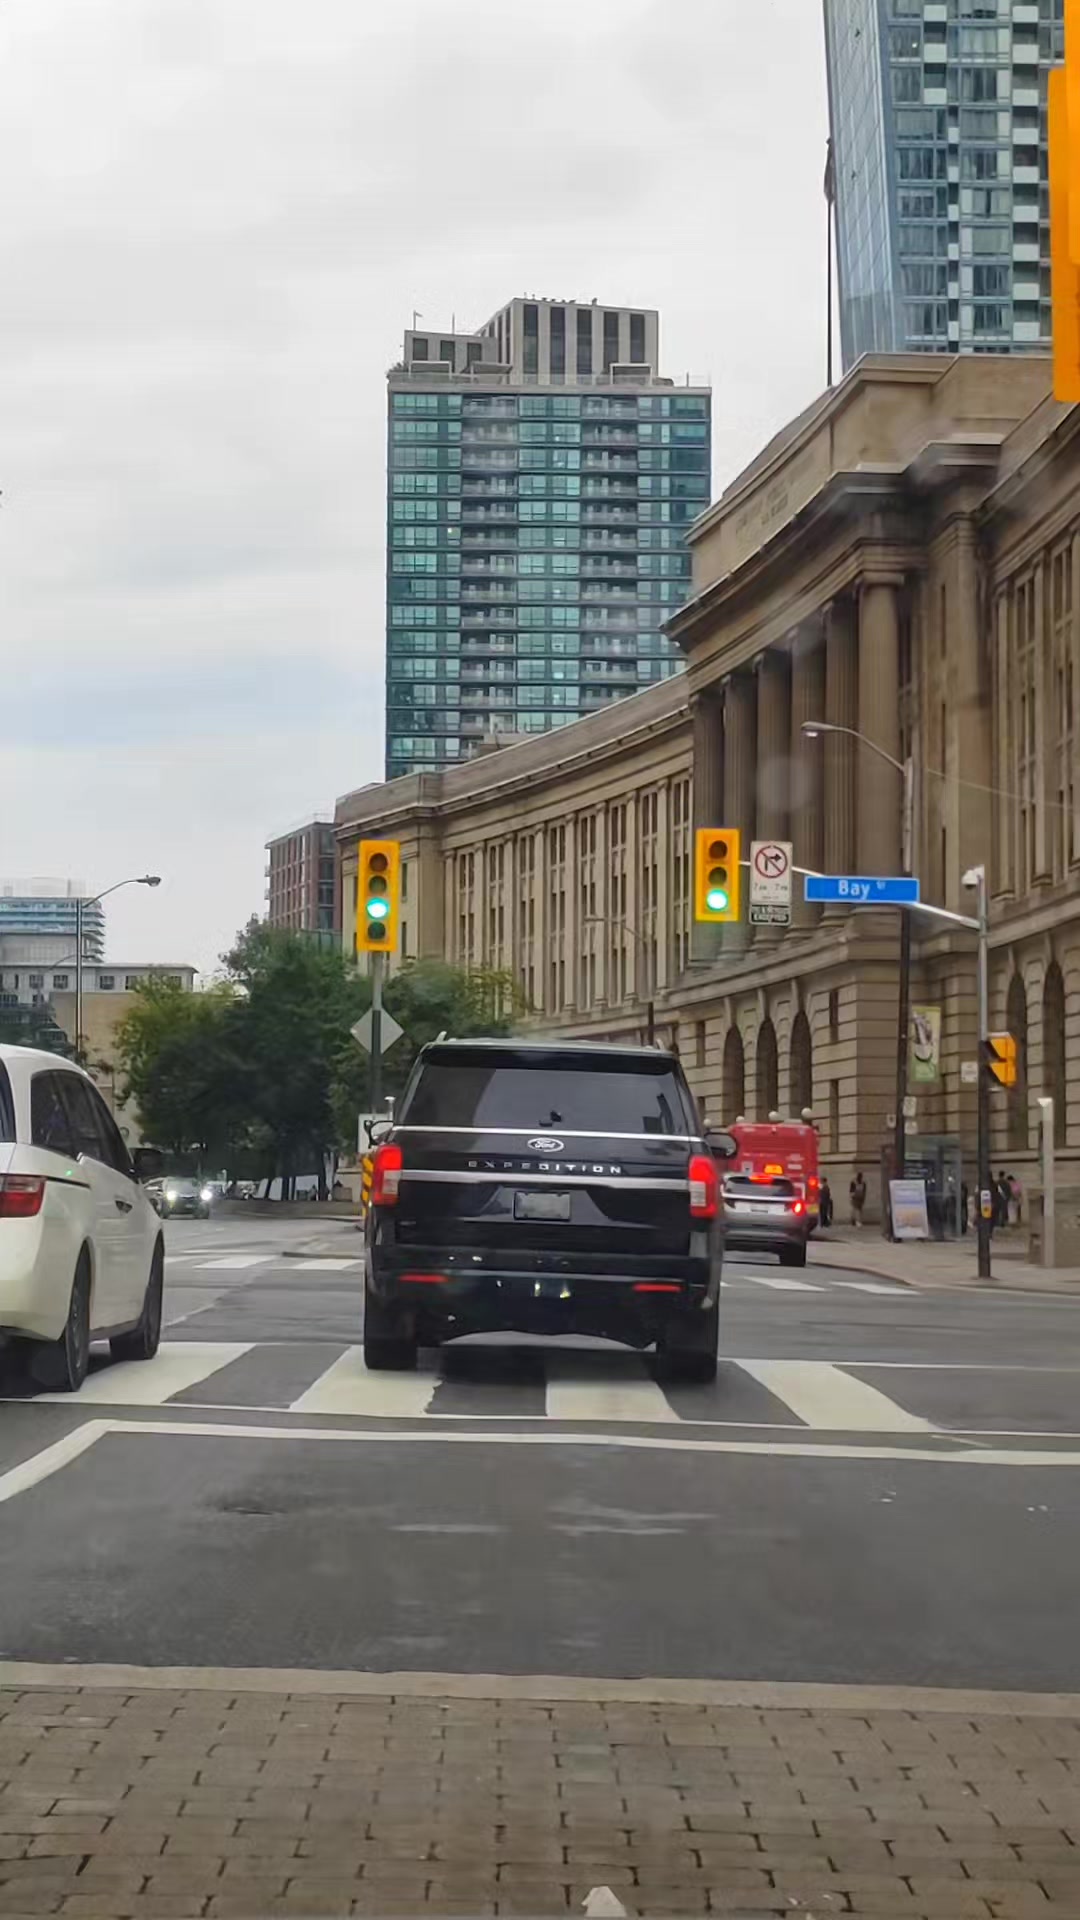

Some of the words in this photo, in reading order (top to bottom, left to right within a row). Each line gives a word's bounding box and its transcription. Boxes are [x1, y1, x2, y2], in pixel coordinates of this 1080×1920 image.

[838, 879, 871, 899] Bay
[532, 1139, 558, 1150] Ford
[468, 1160, 621, 1174] EXPEDITION
